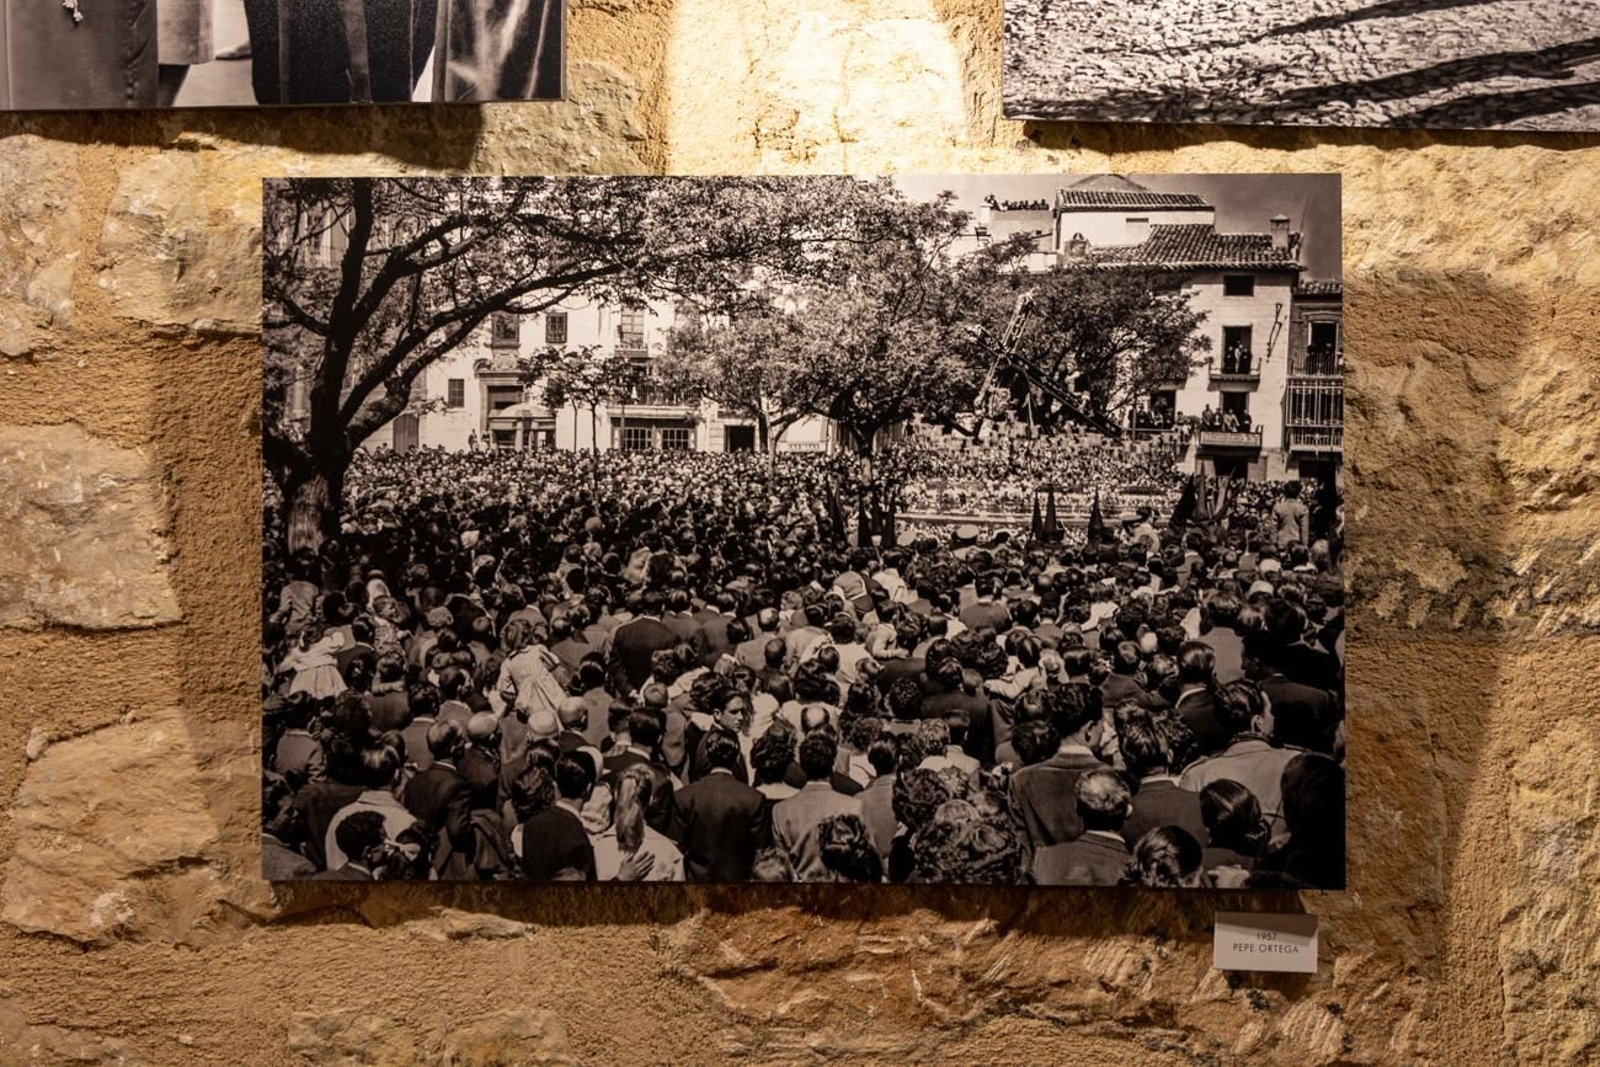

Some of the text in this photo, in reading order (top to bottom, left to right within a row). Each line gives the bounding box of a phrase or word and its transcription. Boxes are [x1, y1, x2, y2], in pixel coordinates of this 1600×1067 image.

[1257, 932, 1278, 941] 1957
[1232, 943, 1299, 954] PEPE ORTEGA
